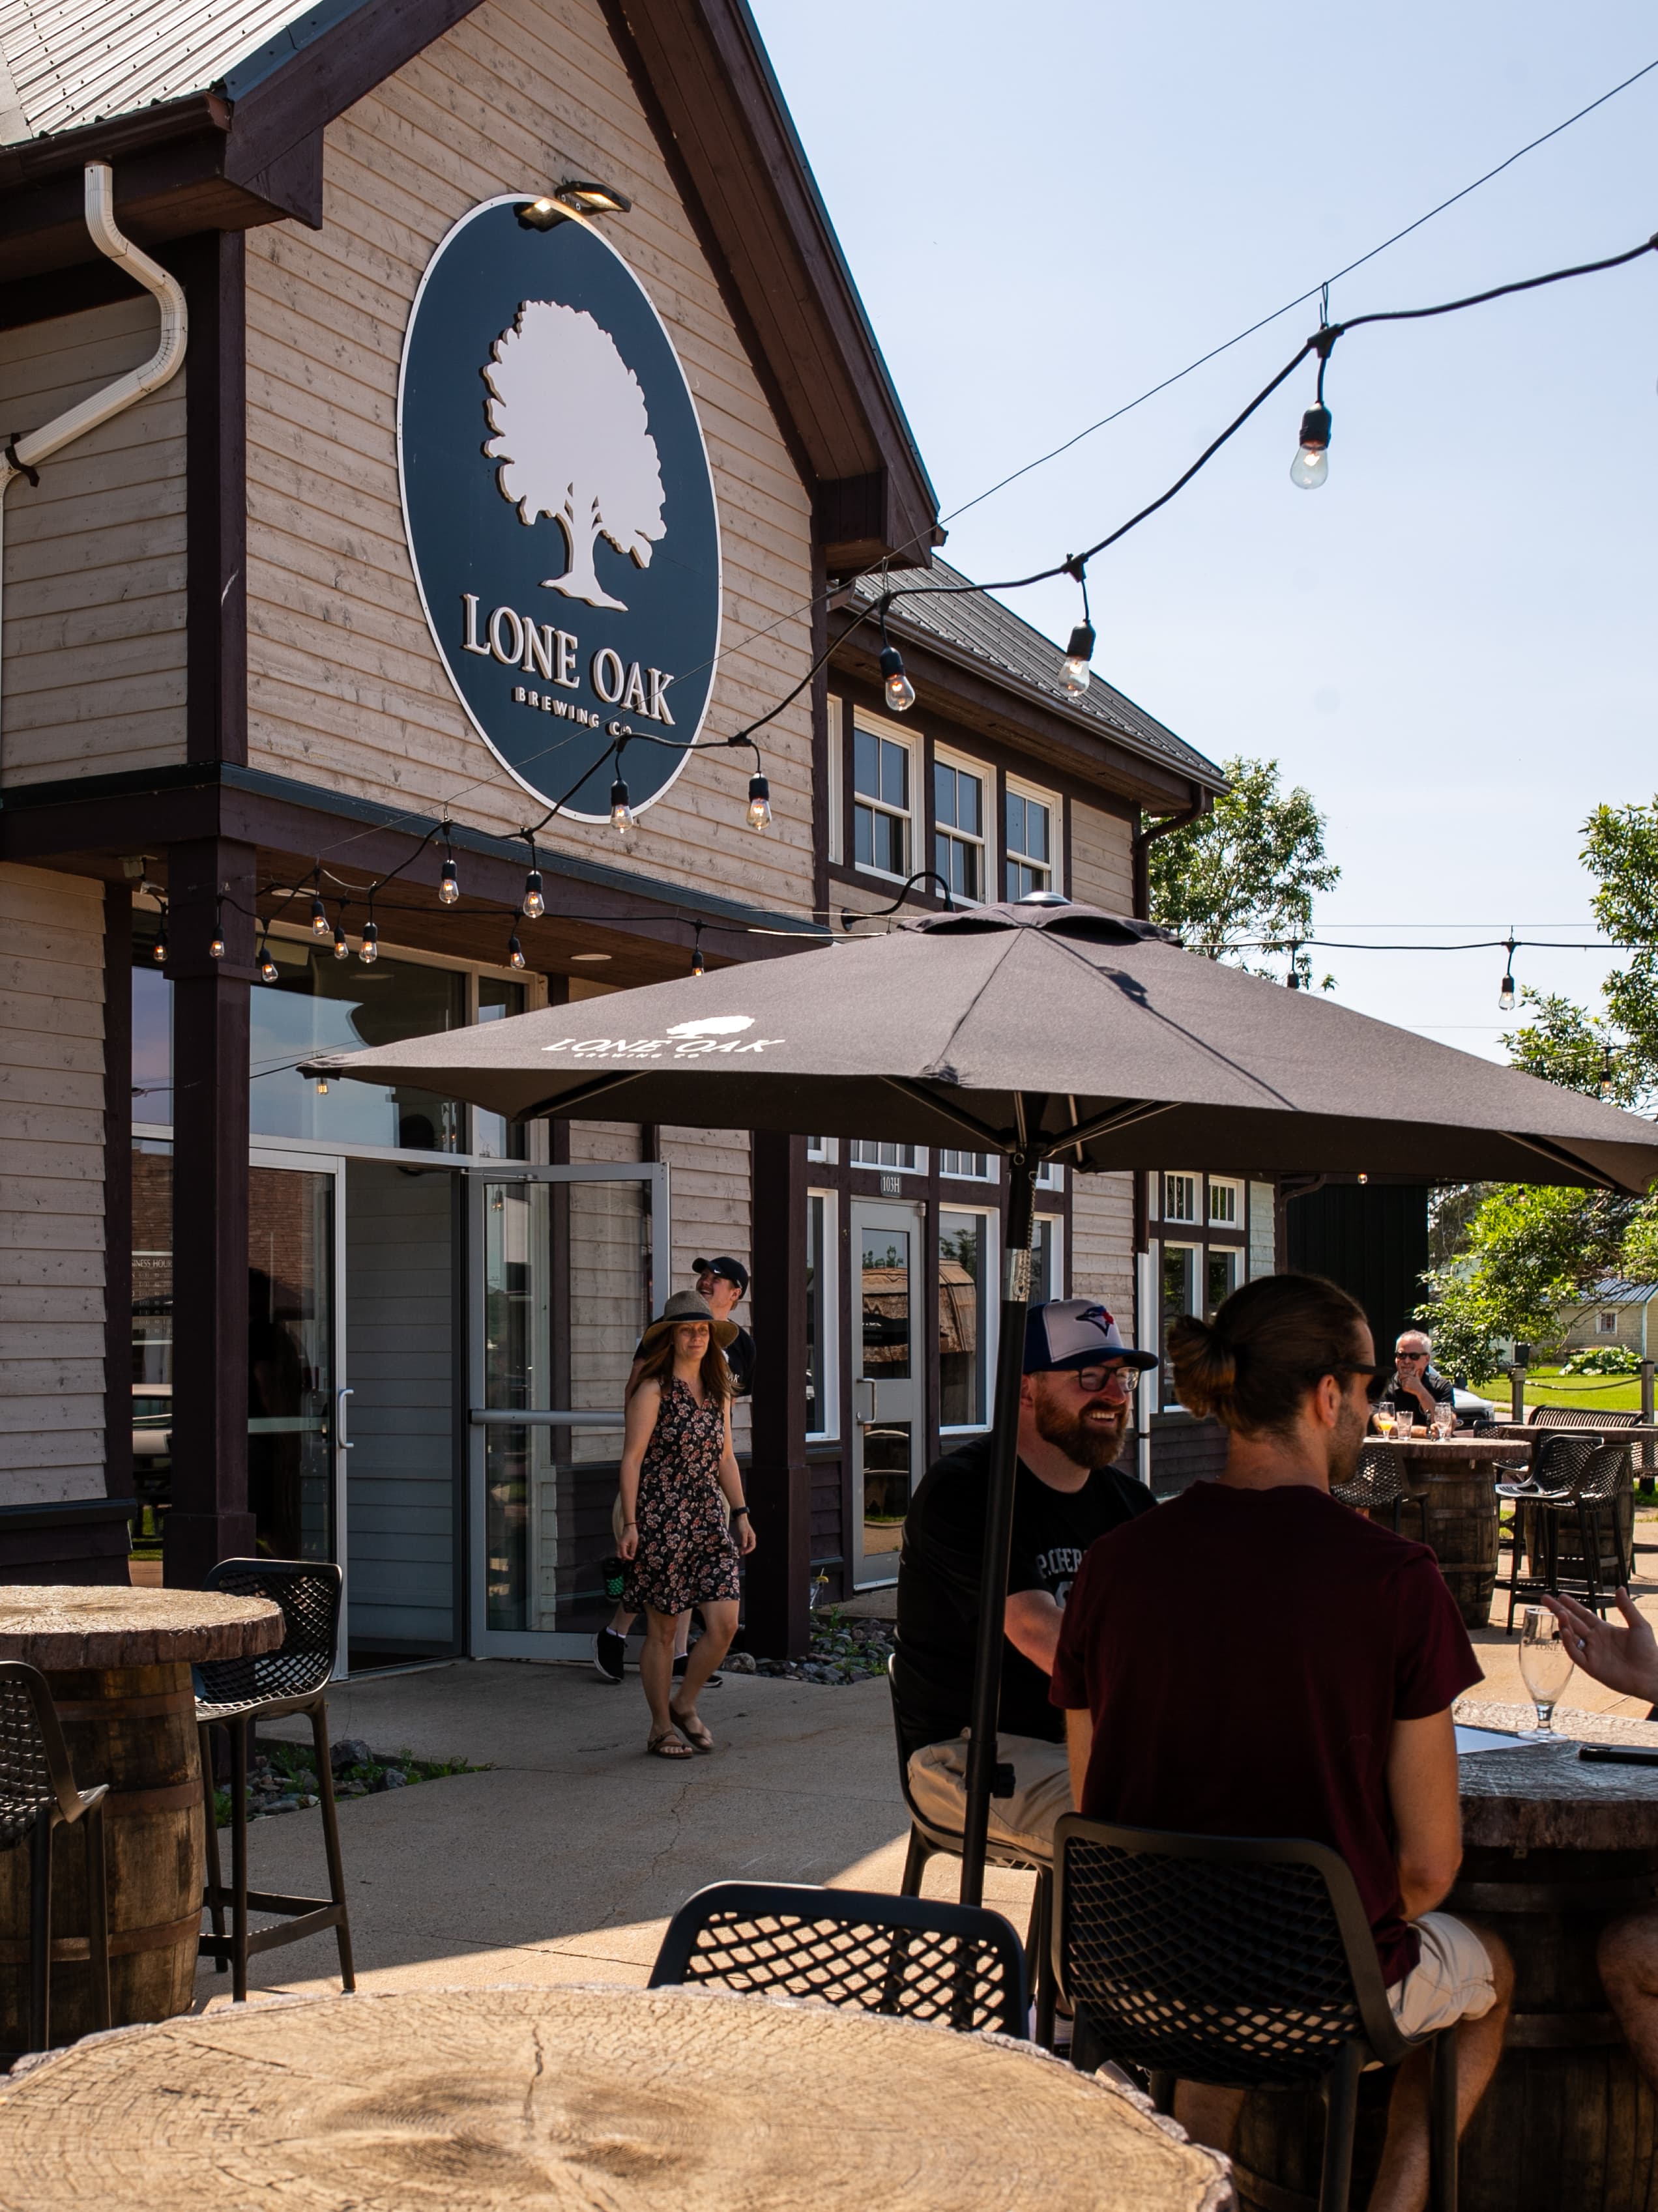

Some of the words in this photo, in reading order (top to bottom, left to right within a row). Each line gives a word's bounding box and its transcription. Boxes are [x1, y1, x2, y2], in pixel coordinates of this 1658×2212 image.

[463, 594, 579, 688] LONE
[593, 648, 675, 725] OAK
[515, 687, 600, 727] BREWING
[542, 1039, 673, 1053] LONE
[675, 1039, 786, 1053] OAK
[883, 1176, 900, 1194] 103H
